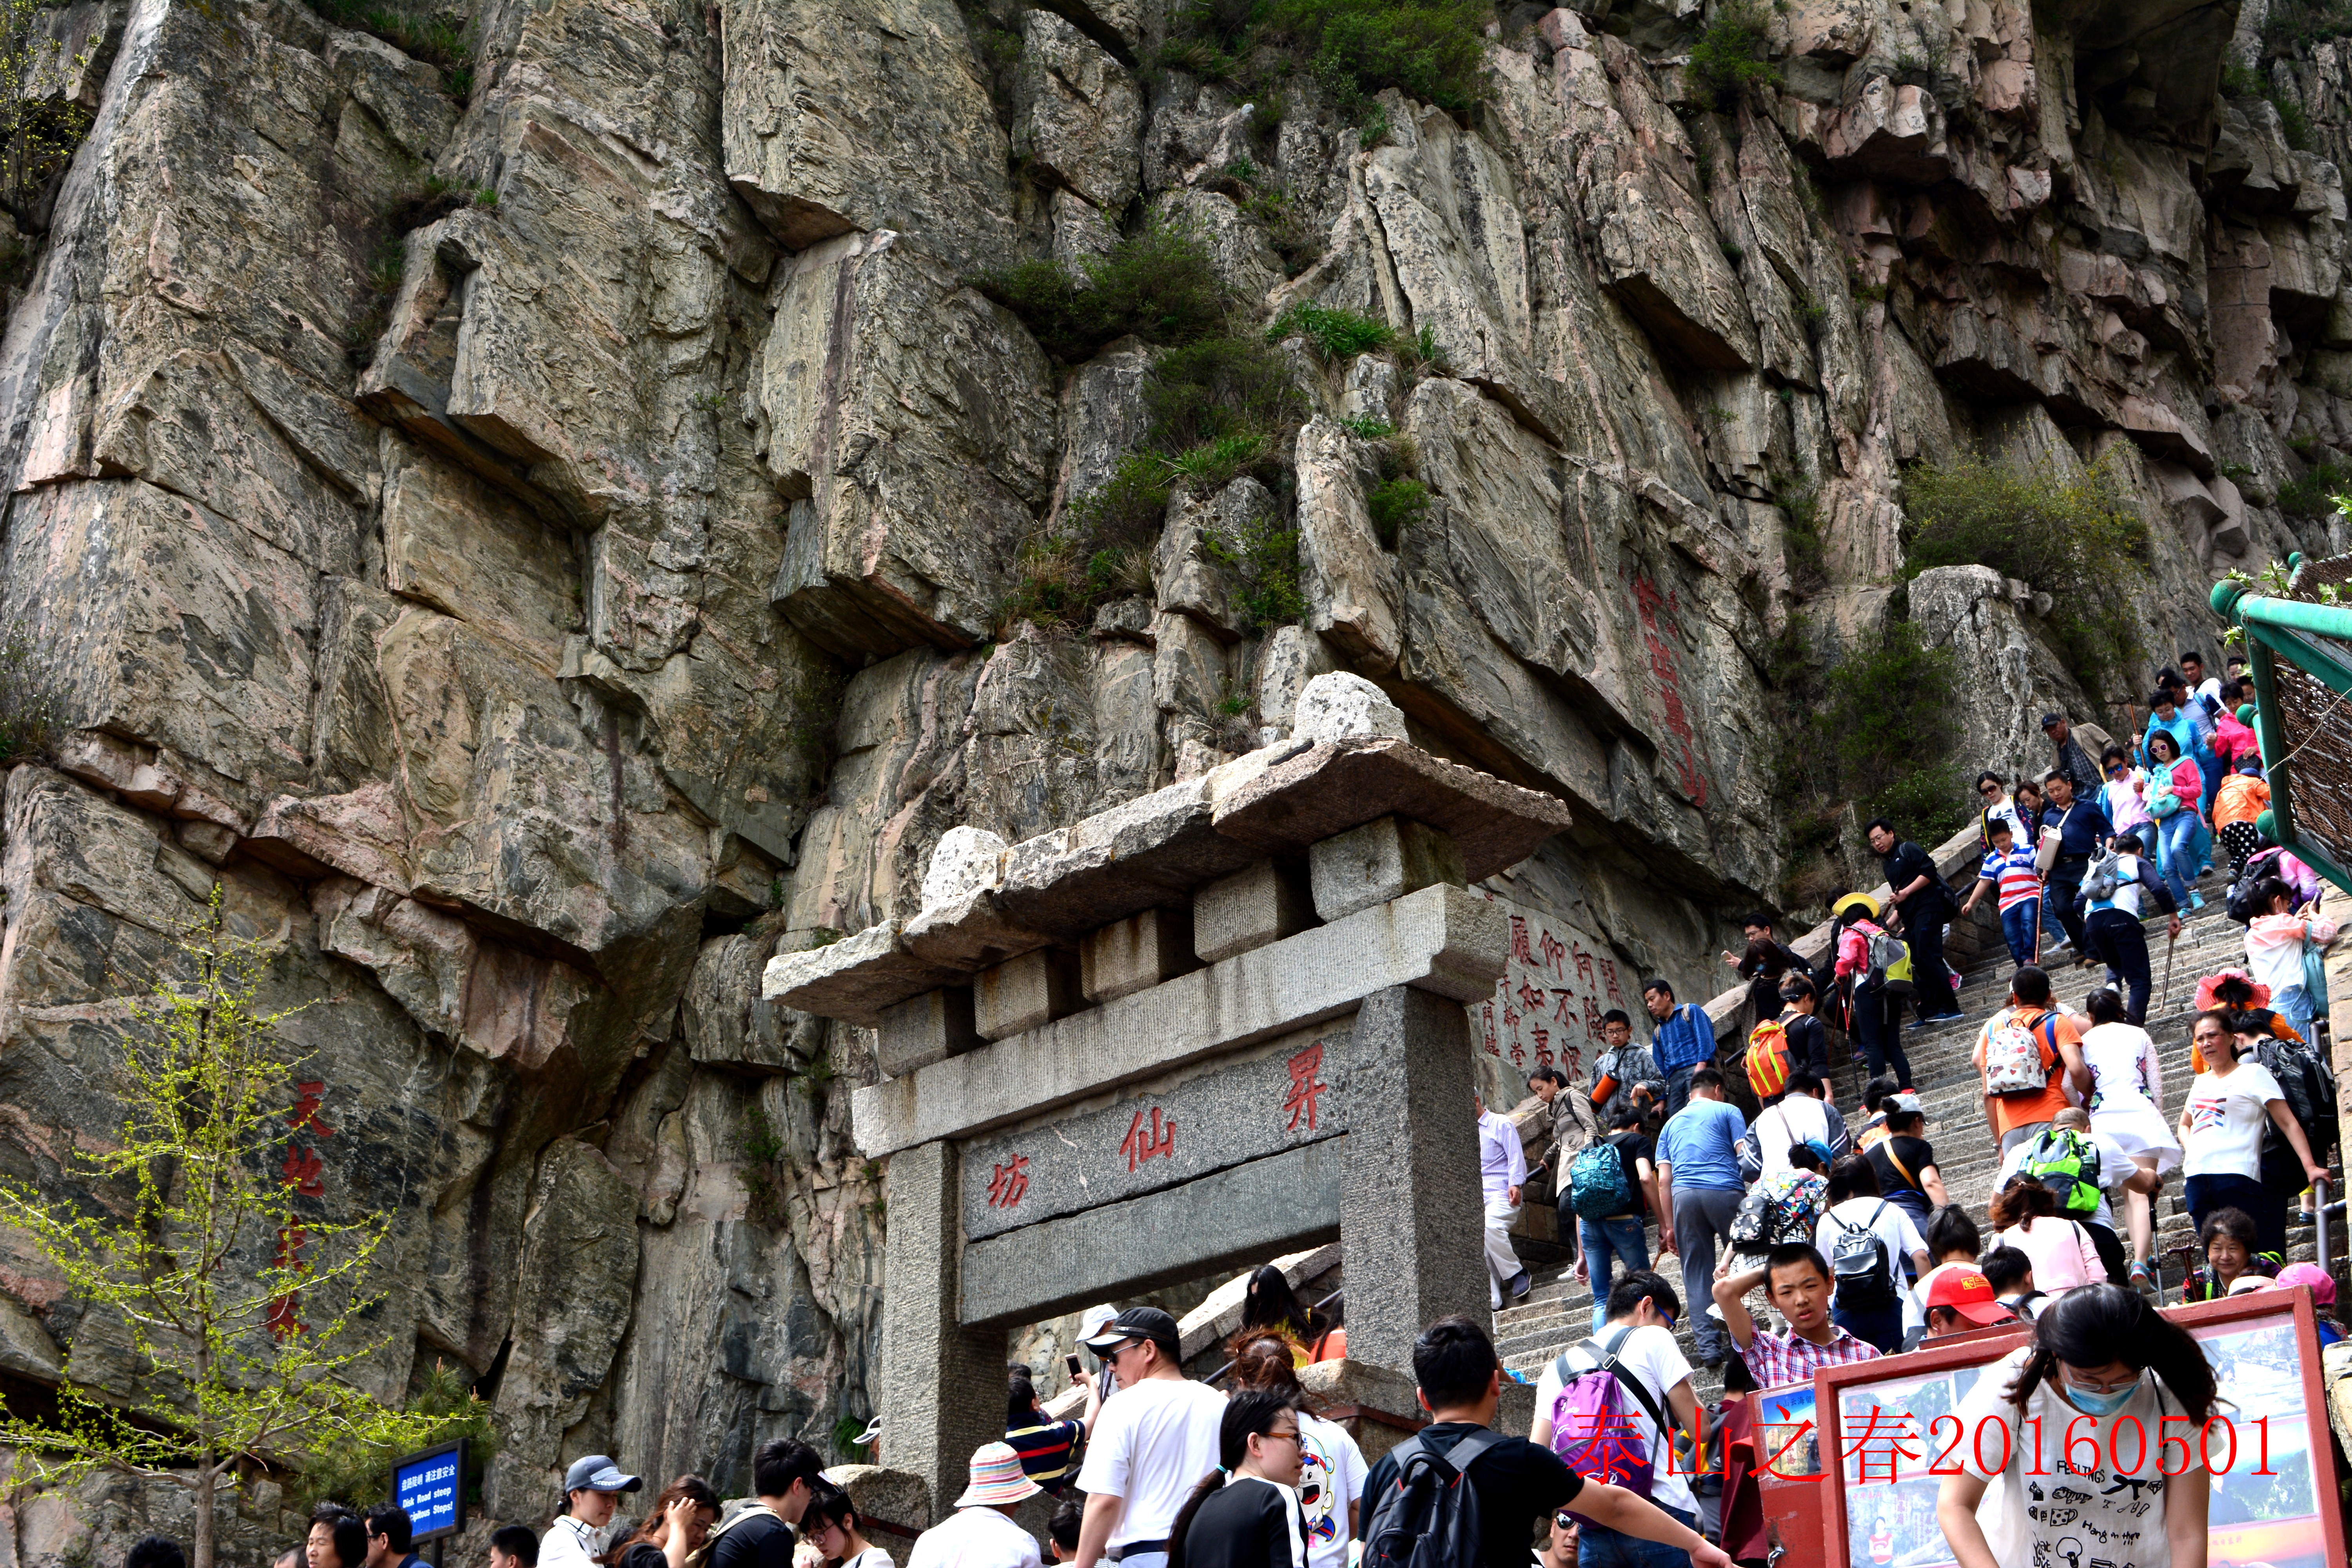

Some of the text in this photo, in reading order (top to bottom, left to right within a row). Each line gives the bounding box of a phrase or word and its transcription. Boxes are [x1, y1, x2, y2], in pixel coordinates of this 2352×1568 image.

[1630, 573, 1707, 807] 首出萬山
[403, 1487, 451, 1508] Disk Road steep
[410, 1501, 453, 1522] cipitous Steps!
[2082, 1520, 2107, 1544] Hang
